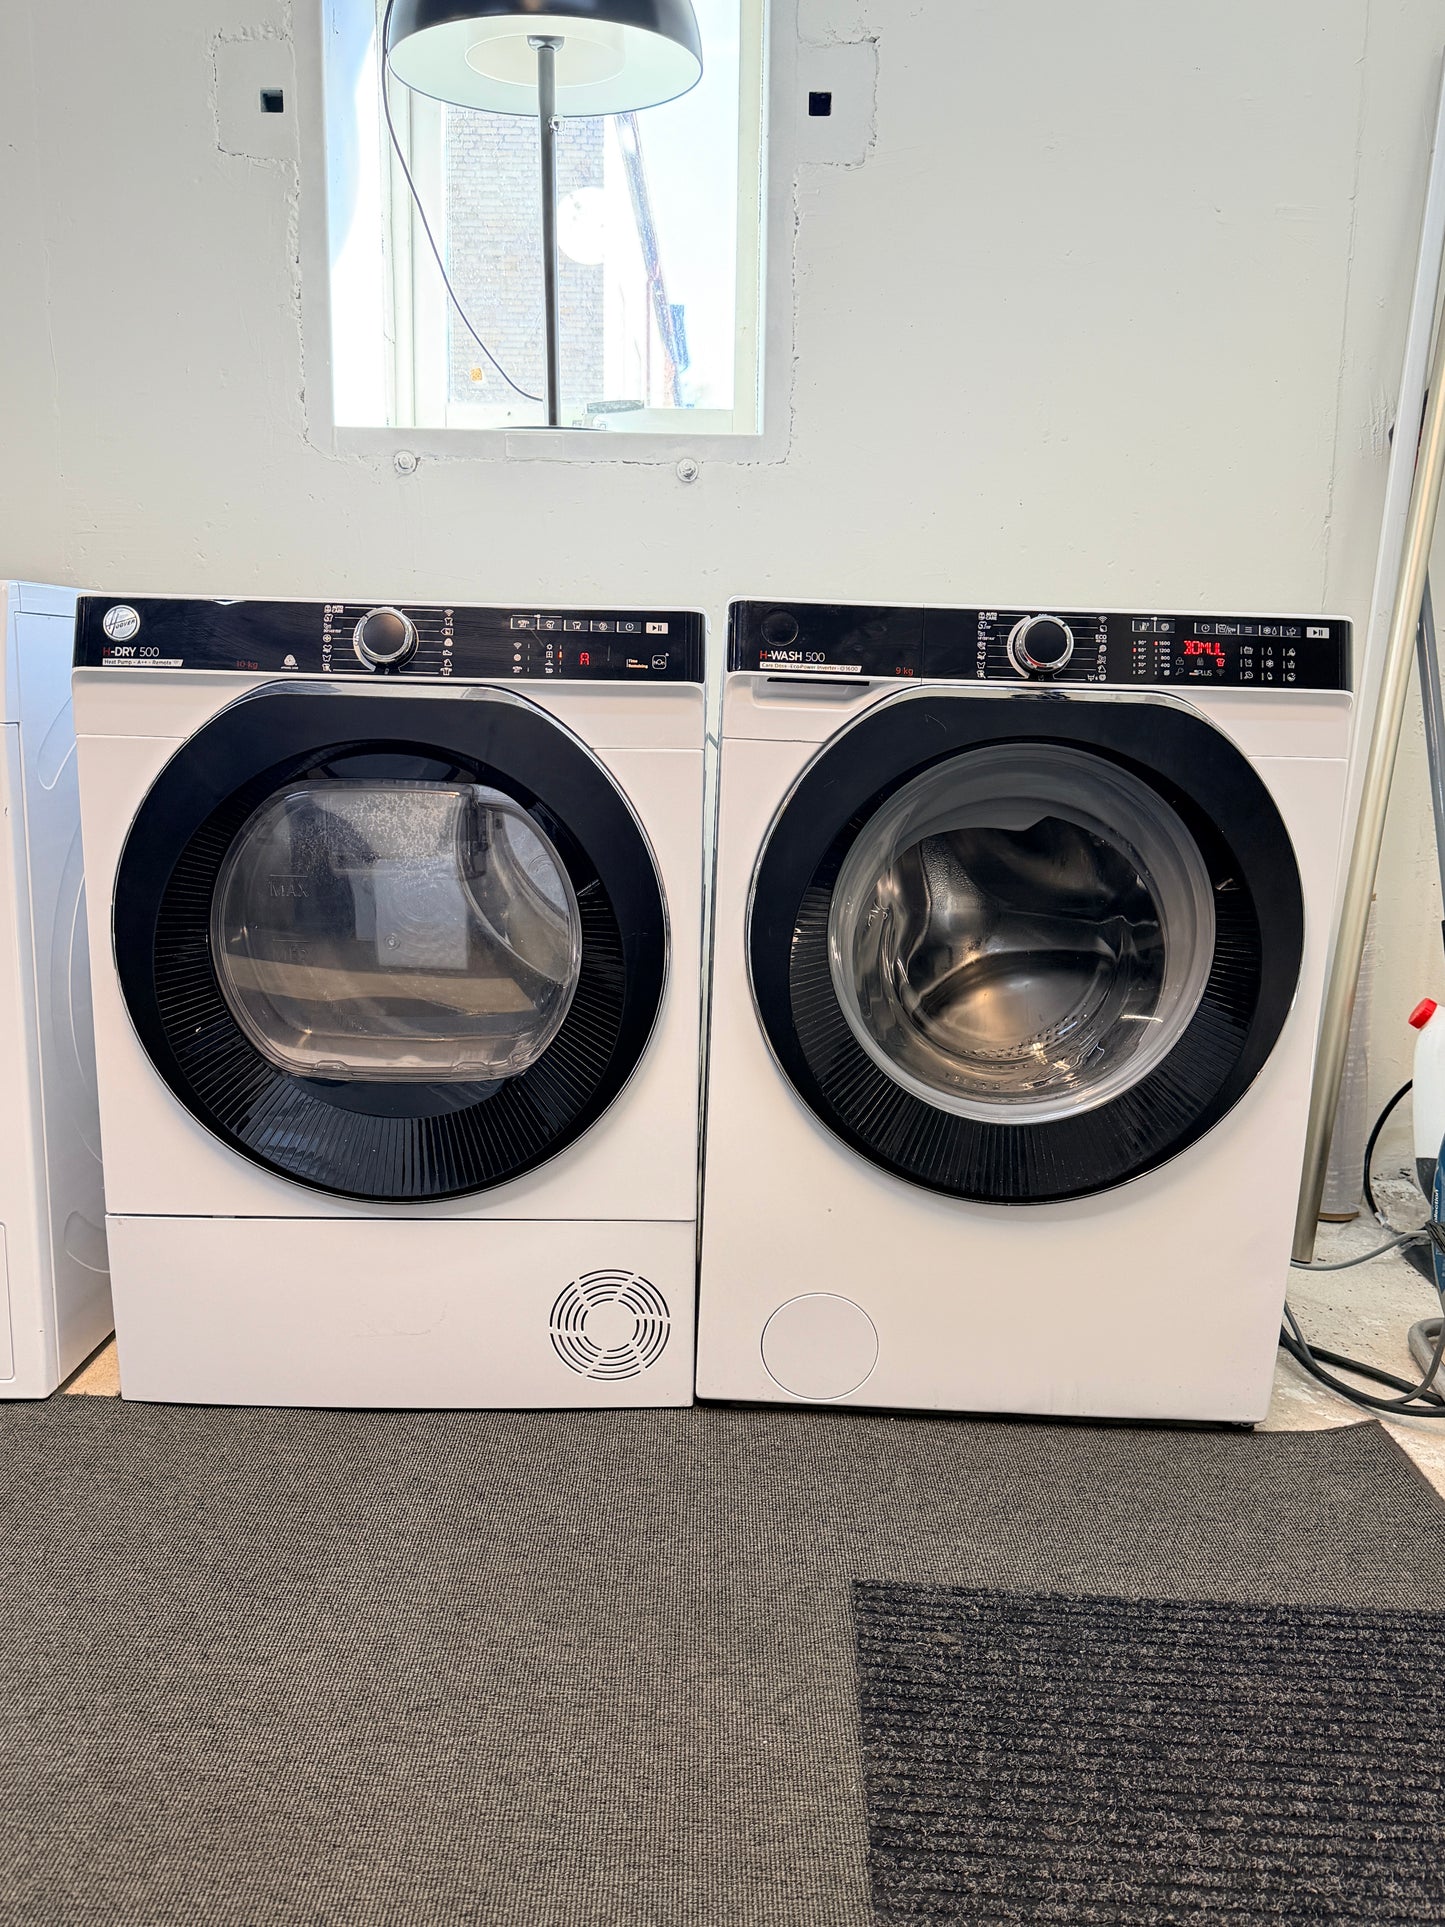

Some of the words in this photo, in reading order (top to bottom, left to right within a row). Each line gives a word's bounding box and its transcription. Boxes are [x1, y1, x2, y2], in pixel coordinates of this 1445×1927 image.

[102, 646, 137, 657] H-DRY
[139, 647, 160, 657] 500
[759, 650, 803, 661] H-WASH
[805, 651, 826, 662] 500
[236, 660, 246, 668] 10
[247, 661, 258, 670] kg
[895, 666, 902, 675] 9
[903, 666, 914, 676] kg
[270, 883, 308, 898] MAX
